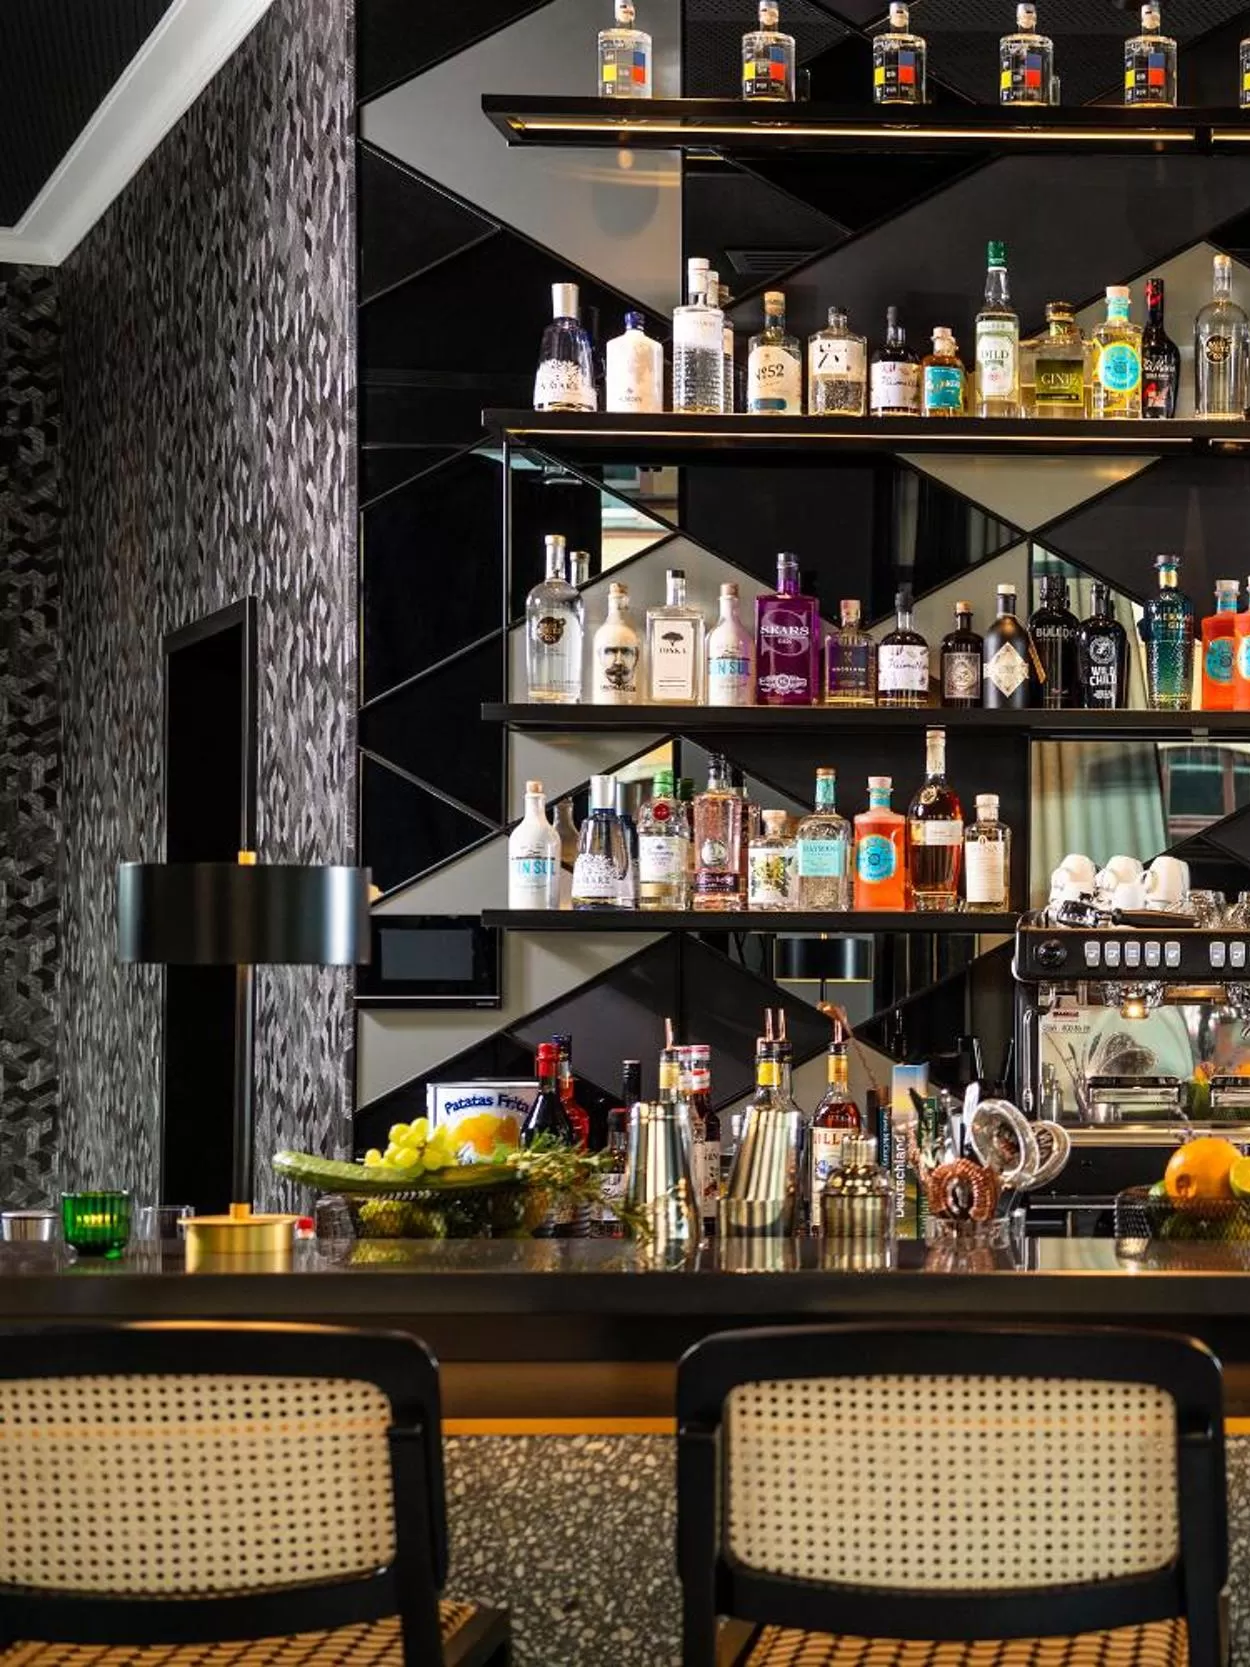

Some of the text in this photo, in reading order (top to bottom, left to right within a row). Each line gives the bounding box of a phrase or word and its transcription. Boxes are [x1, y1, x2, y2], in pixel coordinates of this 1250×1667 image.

[1090, 675, 1117, 686] CHILD
[444, 1092, 531, 1115] Patatas Frita
